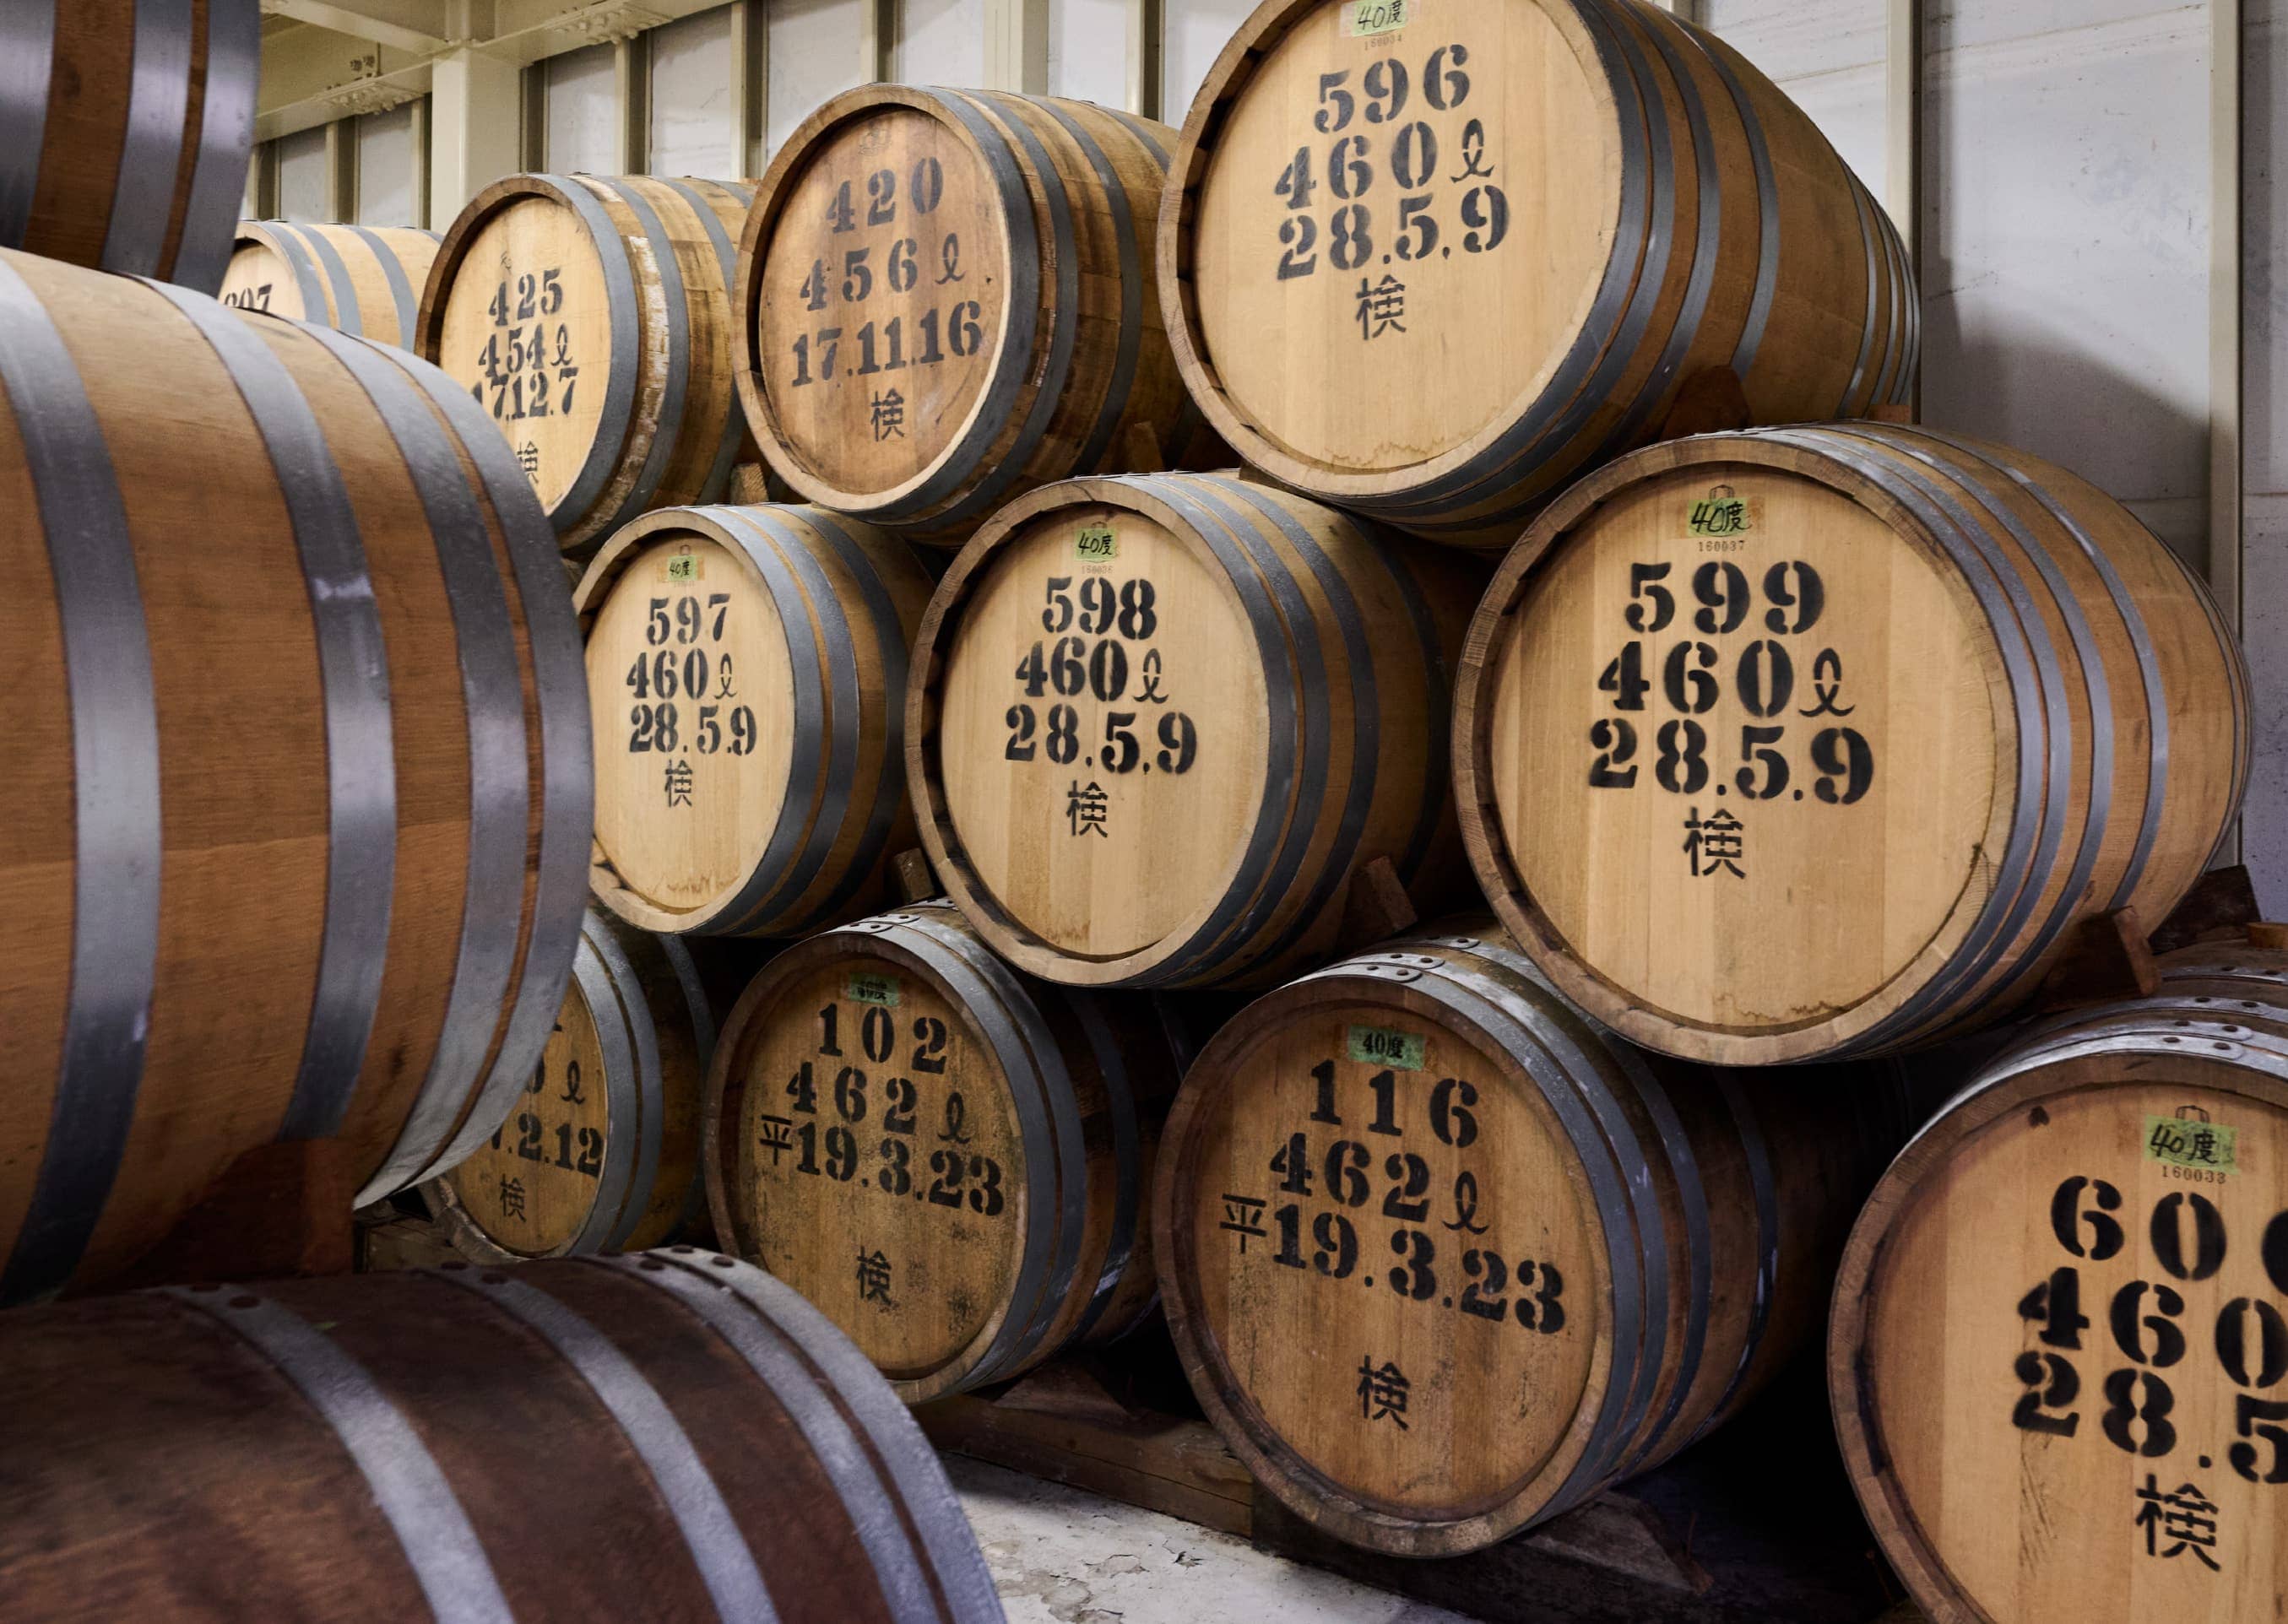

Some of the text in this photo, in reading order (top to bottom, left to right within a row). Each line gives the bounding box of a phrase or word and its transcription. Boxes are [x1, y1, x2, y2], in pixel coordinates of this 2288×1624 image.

[1315, 44, 1471, 133] 596
[827, 156, 944, 234] 420
[1277, 185, 1510, 281] 28.5.9
[489, 268, 563, 327] 425
[1354, 274, 1407, 341] 検
[870, 388, 906, 442] 検
[1078, 532, 1113, 555] 40度
[1691, 501, 1753, 533] 40度
[647, 593, 731, 647] 597
[1042, 577, 1158, 640] 598
[1624, 560, 1825, 635] 599
[629, 701, 757, 756] 28.5.9
[1005, 703, 1197, 774] 28.5.9
[664, 759, 693, 808] 検
[1588, 718, 1874, 805] 28.5.9
[1065, 780, 1109, 838] 検
[1683, 807, 1747, 880] 検
[819, 1003, 947, 1075] 102
[1363, 1032, 1406, 1059] 40度
[1309, 1059, 1480, 1149] 116
[2150, 1123, 2219, 1164] 40度
[500, 1173, 528, 1223] 検
[855, 1246, 892, 1307] 検
[2016, 1266, 2288, 1391] 460
[1356, 1355, 1410, 1432] 検
[2135, 1472, 2220, 1573] 検
